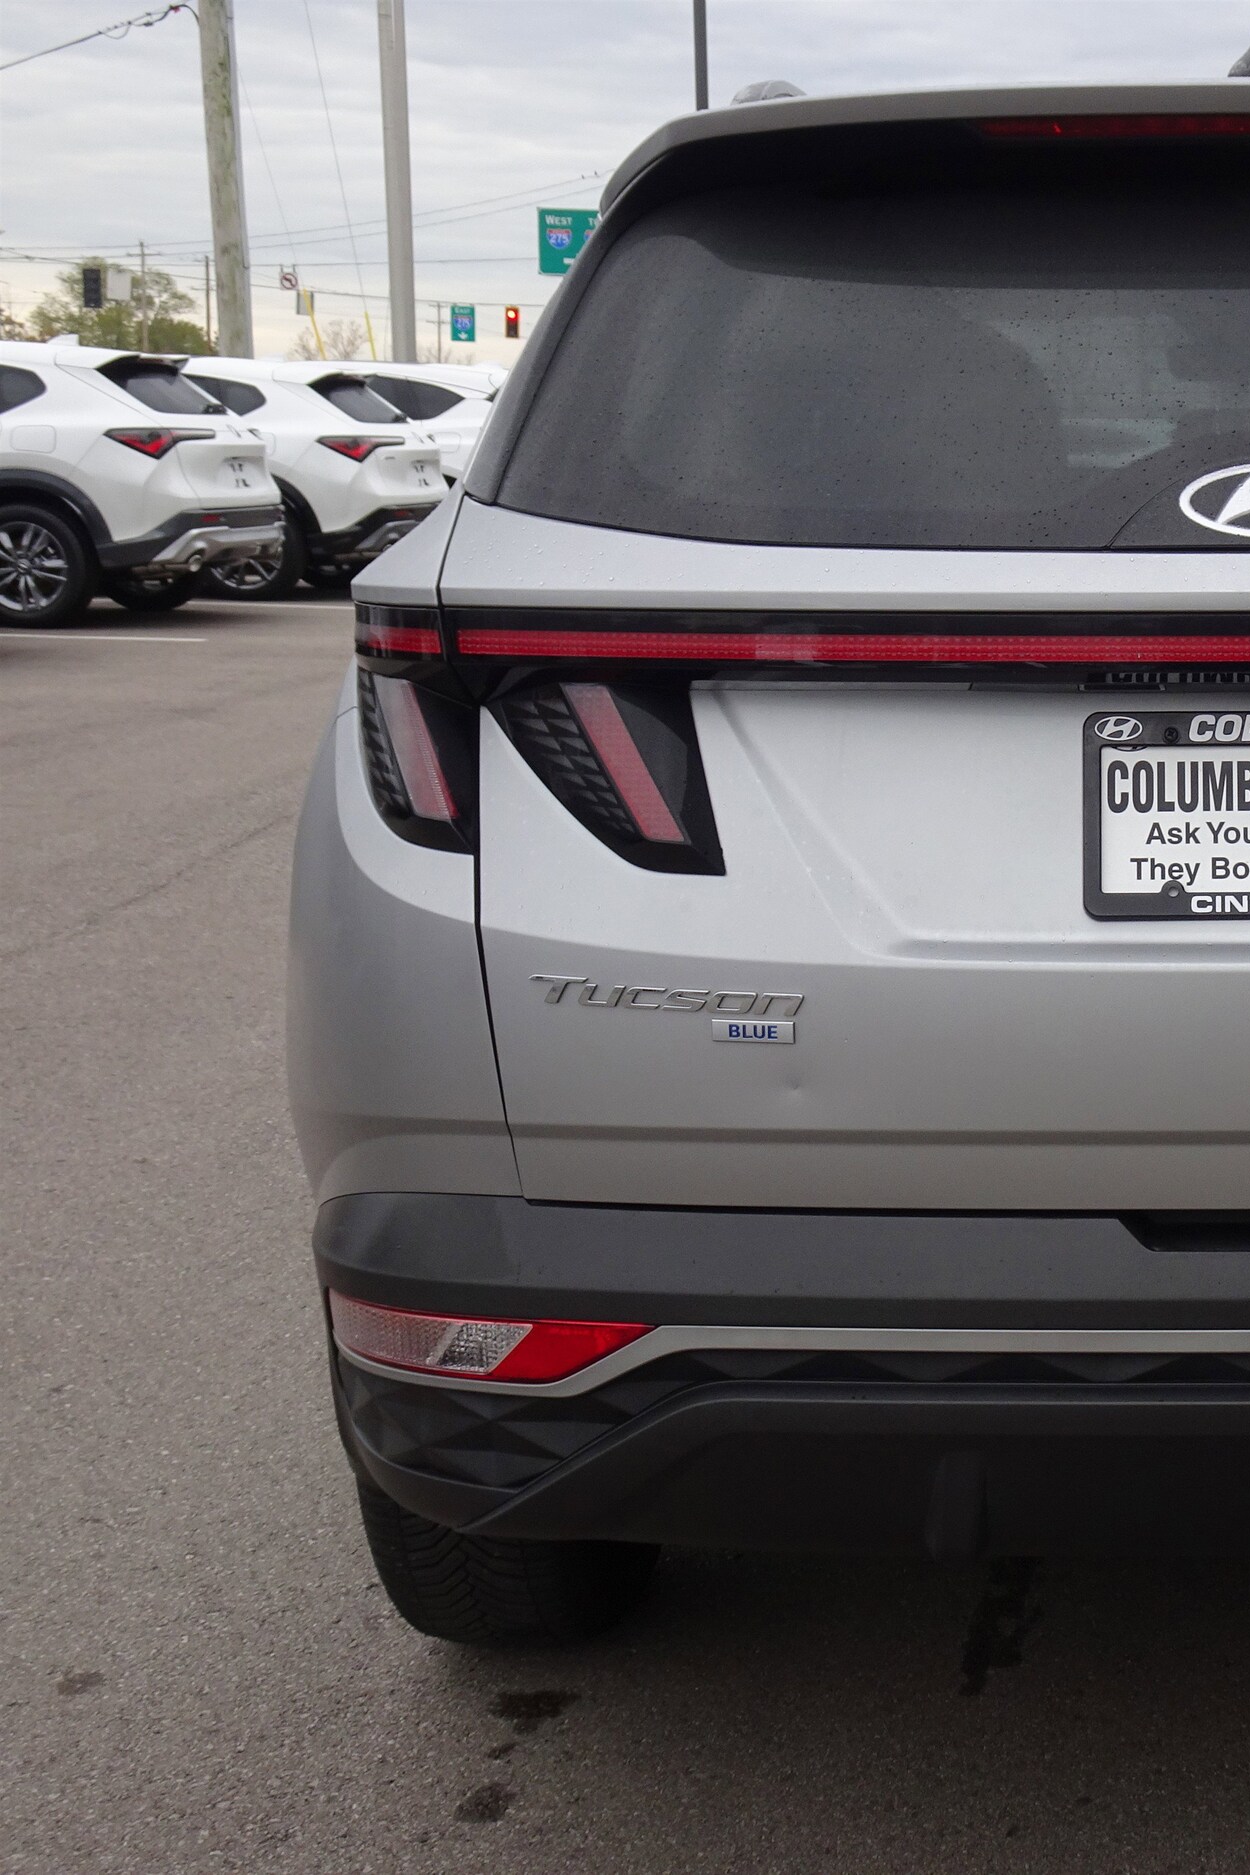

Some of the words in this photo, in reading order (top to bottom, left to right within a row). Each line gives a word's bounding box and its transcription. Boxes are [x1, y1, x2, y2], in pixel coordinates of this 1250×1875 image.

[545, 214, 572, 225] WEST
[550, 233, 569, 243] 275
[1145, 822, 1200, 845] Ask
[1130, 857, 1200, 886] They
[728, 1024, 778, 1040] BLUE
